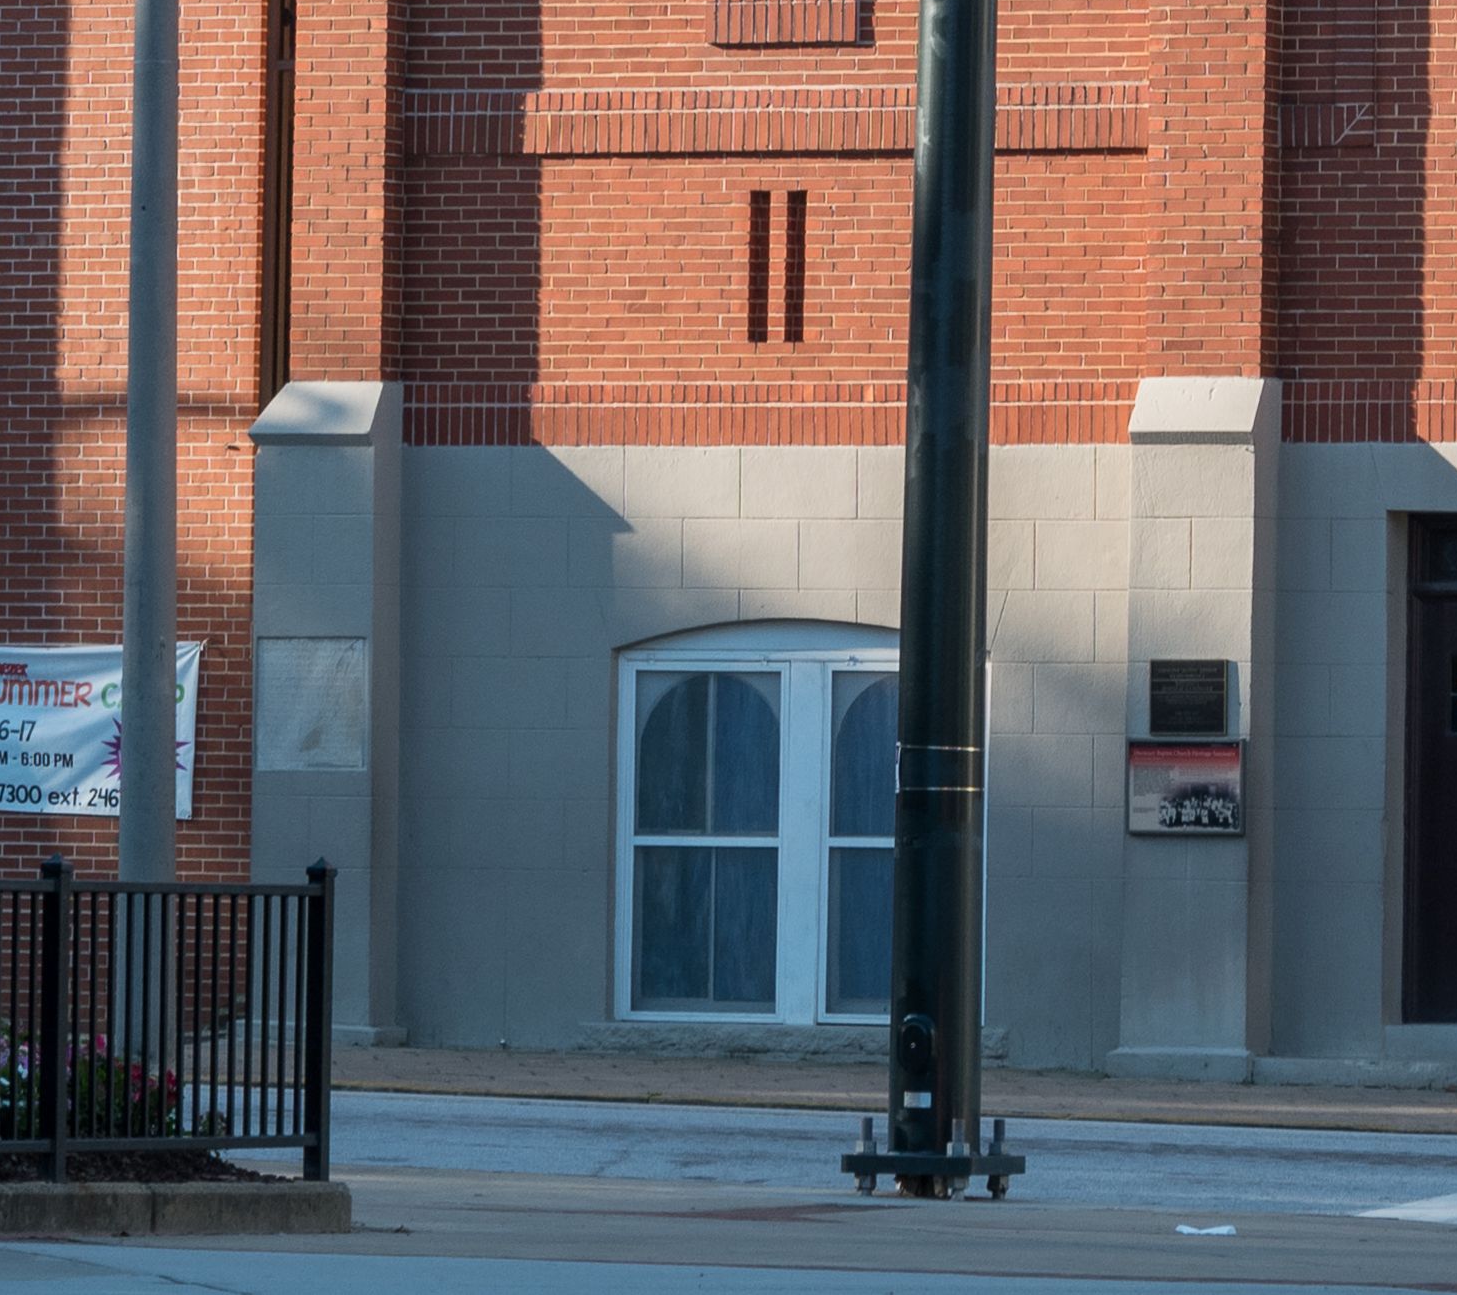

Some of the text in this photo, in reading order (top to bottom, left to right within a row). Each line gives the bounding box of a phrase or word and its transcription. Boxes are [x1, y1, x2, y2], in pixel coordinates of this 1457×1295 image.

[20, 750, 50, 768] 6:00
[53, 753, 74, 769] PM
[47, 786, 82, 807] ext.
[87, 787, 119, 808] 246
